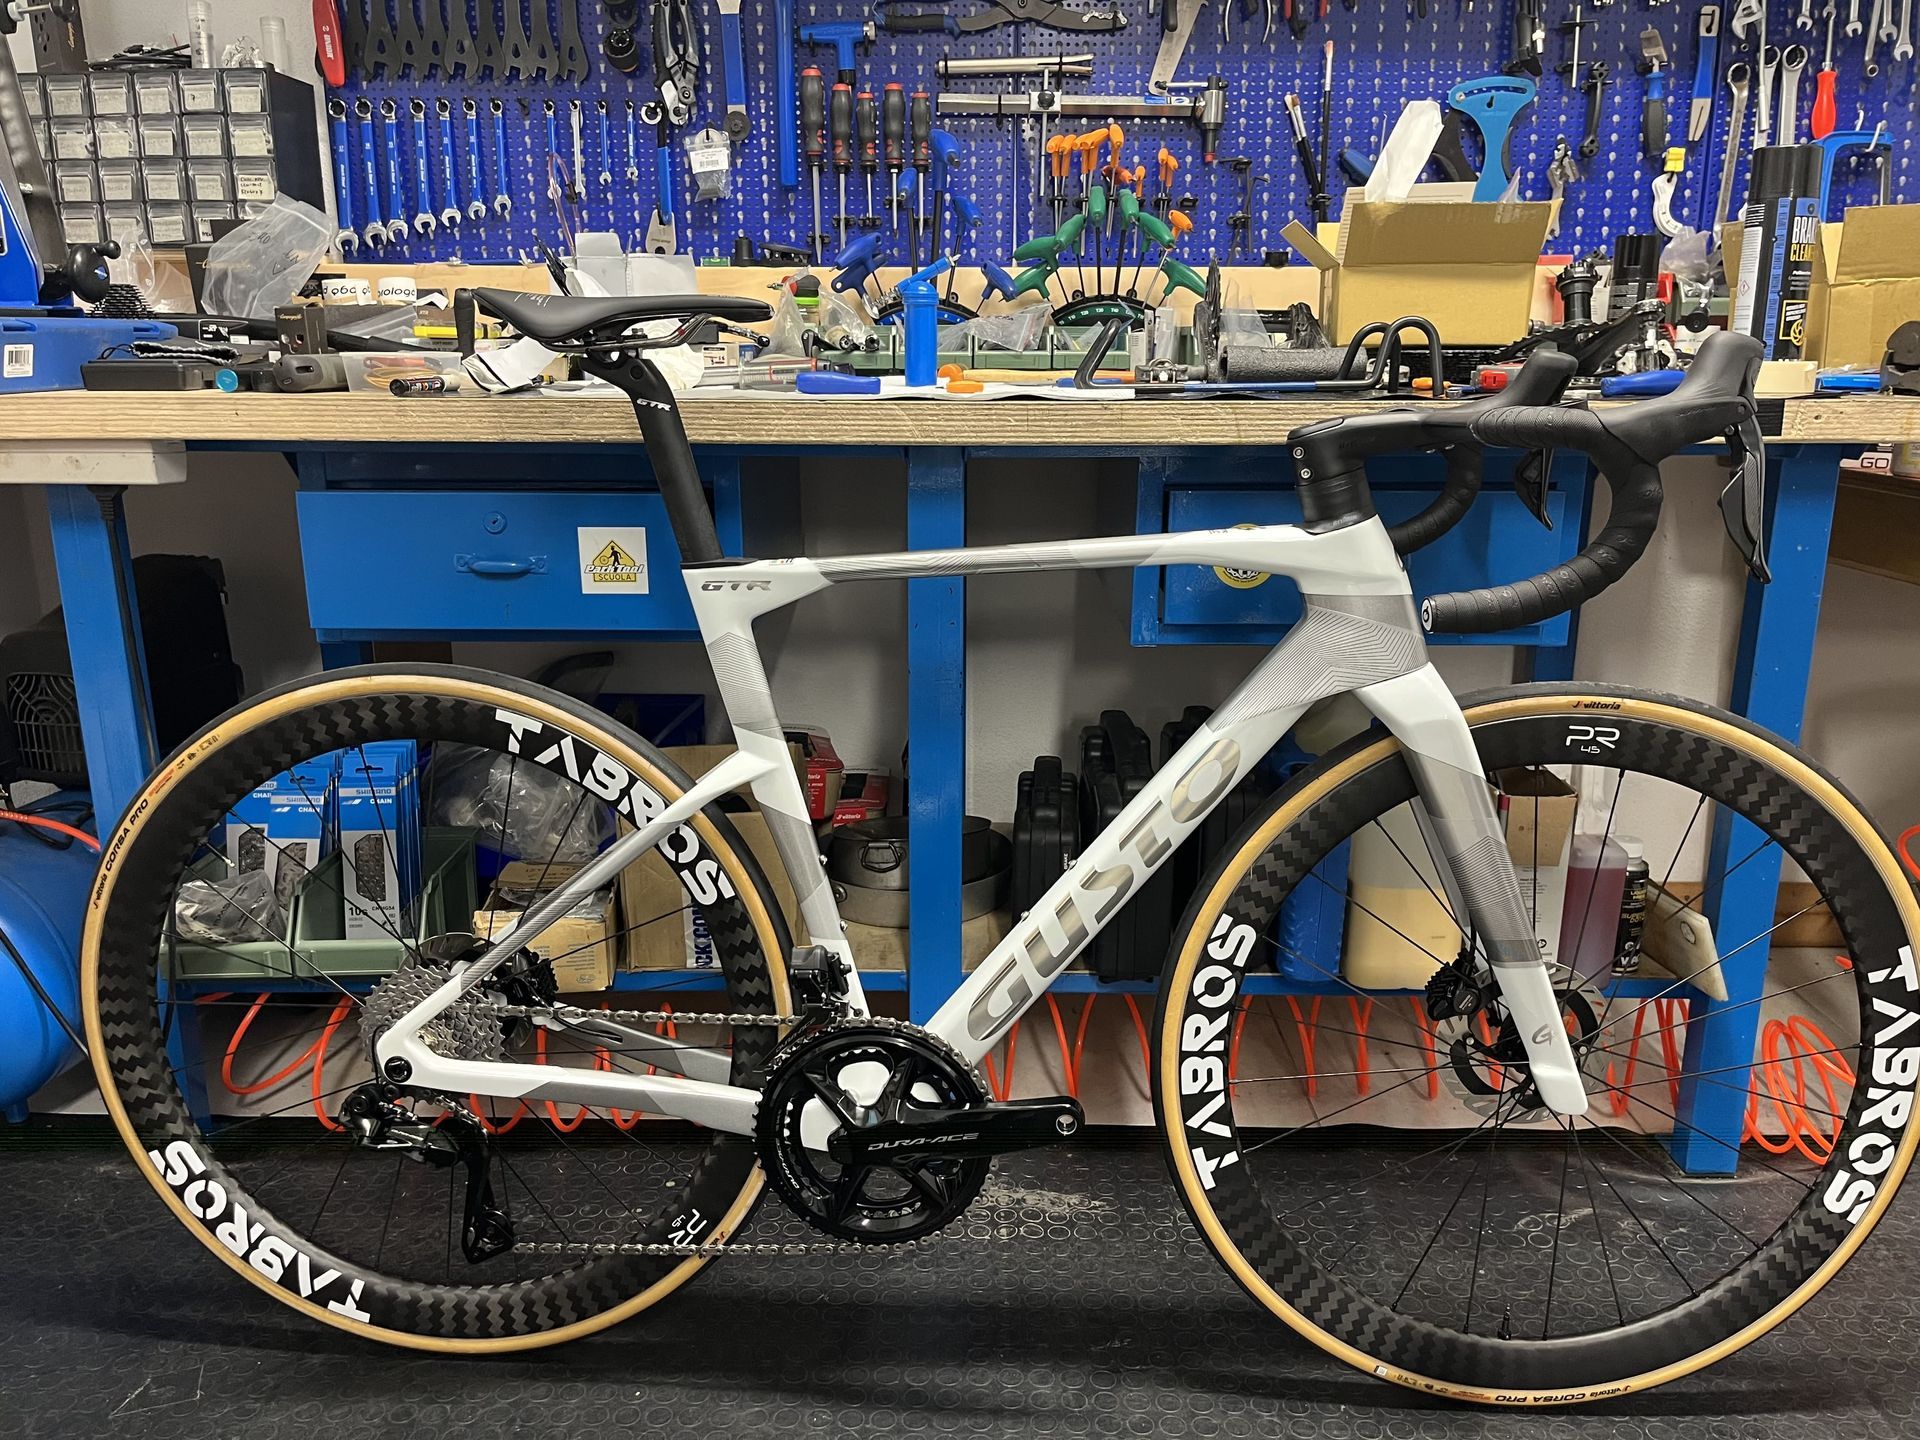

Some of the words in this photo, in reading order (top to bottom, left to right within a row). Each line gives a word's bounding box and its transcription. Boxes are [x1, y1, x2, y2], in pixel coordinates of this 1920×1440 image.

[636, 397, 672, 412] GTR
[1861, 457, 1890, 469] GO
[598, 573, 632, 581] SCUOLA
[701, 580, 772, 592] GTR
[1584, 701, 1622, 710] vittoria
[1565, 725, 1621, 749] PR
[1580, 745, 1601, 754] 45
[495, 708, 736, 906] TABROS
[105, 828, 131, 872] CORSA
[130, 798, 149, 826] PRO
[967, 738, 1241, 1042] GUSTO
[1180, 913, 1257, 1190] TABROS
[1823, 945, 1920, 1225] TABROS
[867, 1132, 980, 1151] DURA-ACE
[147, 1139, 371, 1323] TABROS
[1495, 1394, 1527, 1403] PRO
[1533, 1393, 1586, 1403] CORSA
